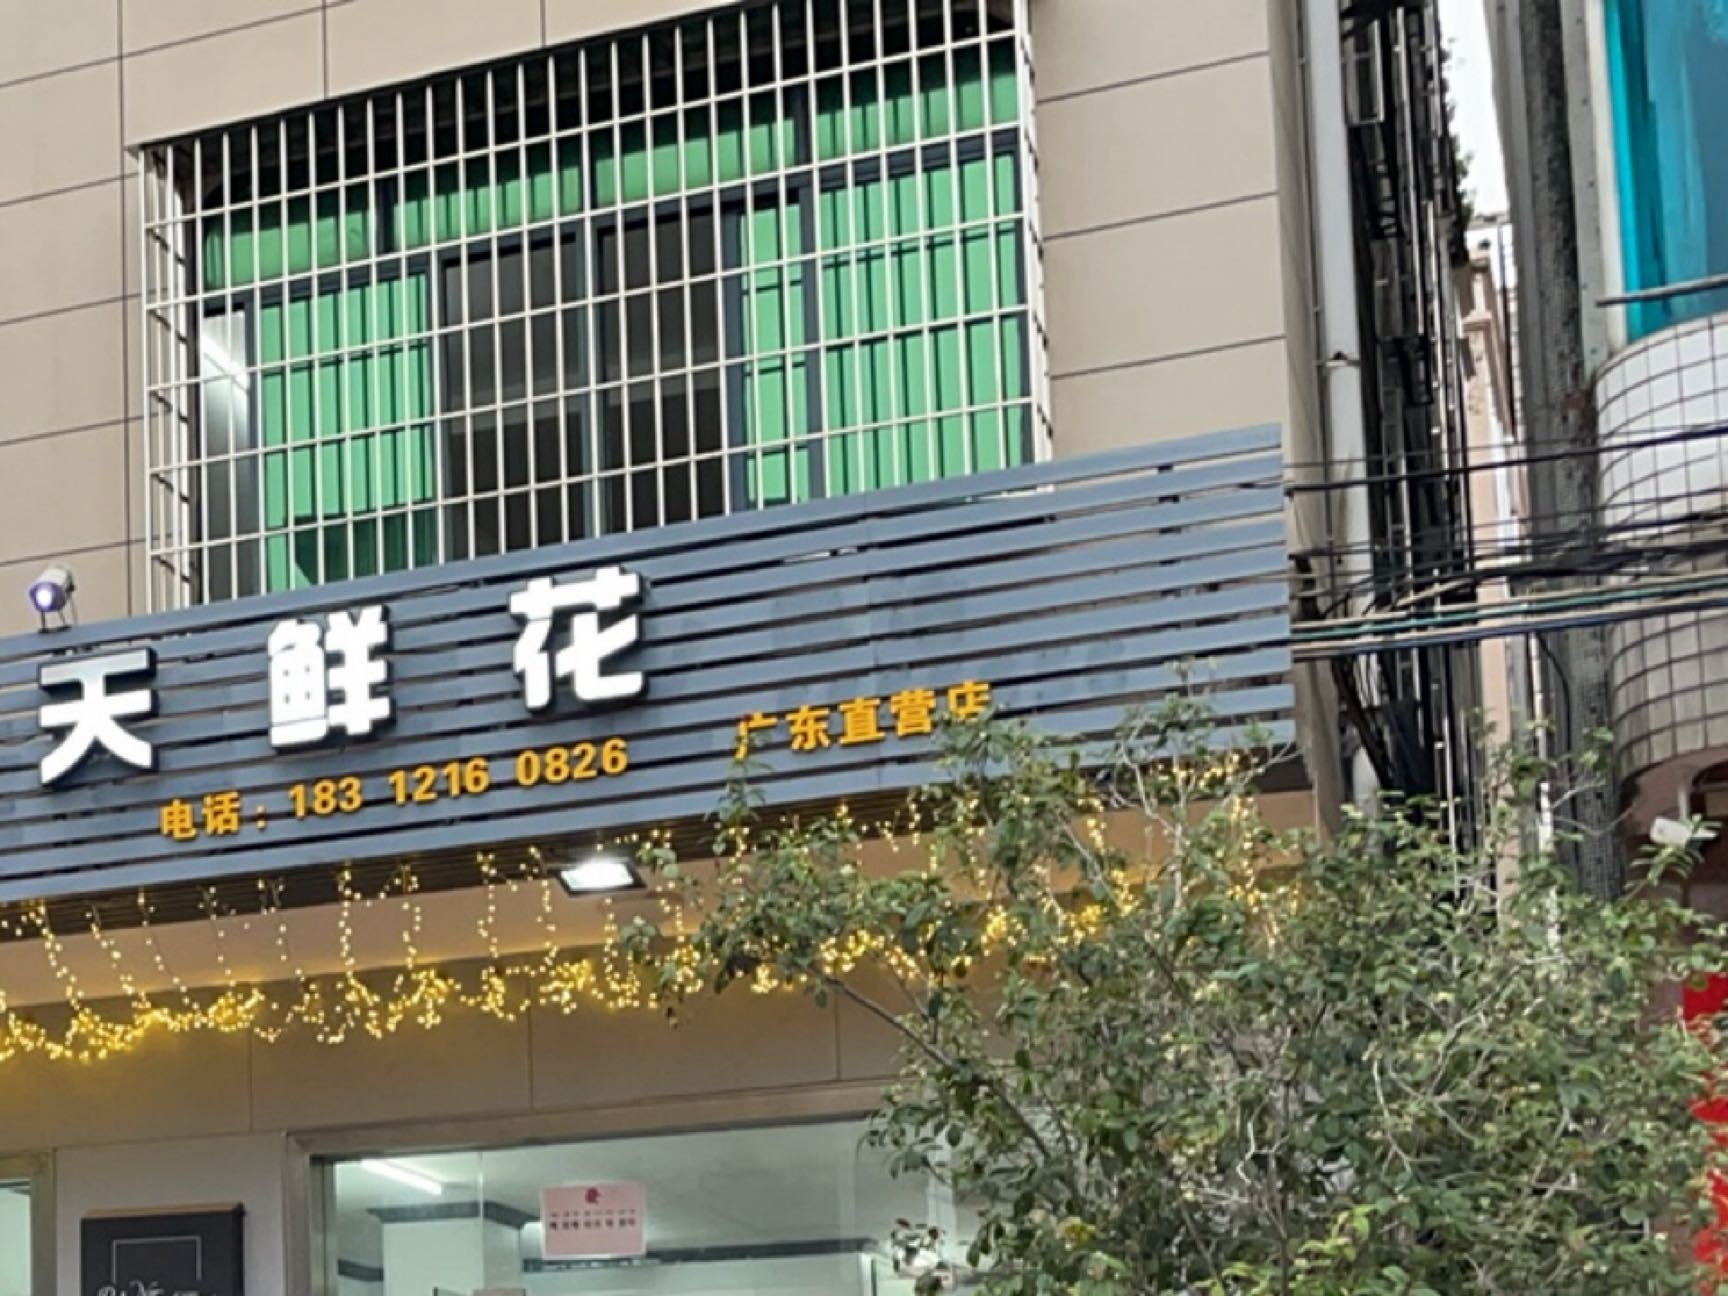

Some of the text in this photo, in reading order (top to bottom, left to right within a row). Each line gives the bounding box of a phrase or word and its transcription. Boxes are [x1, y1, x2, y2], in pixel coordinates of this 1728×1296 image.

[734, 679, 992, 761] 广东直营店
[287, 776, 364, 818] 183
[387, 757, 491, 806] 1216
[515, 737, 629, 787] 0826
